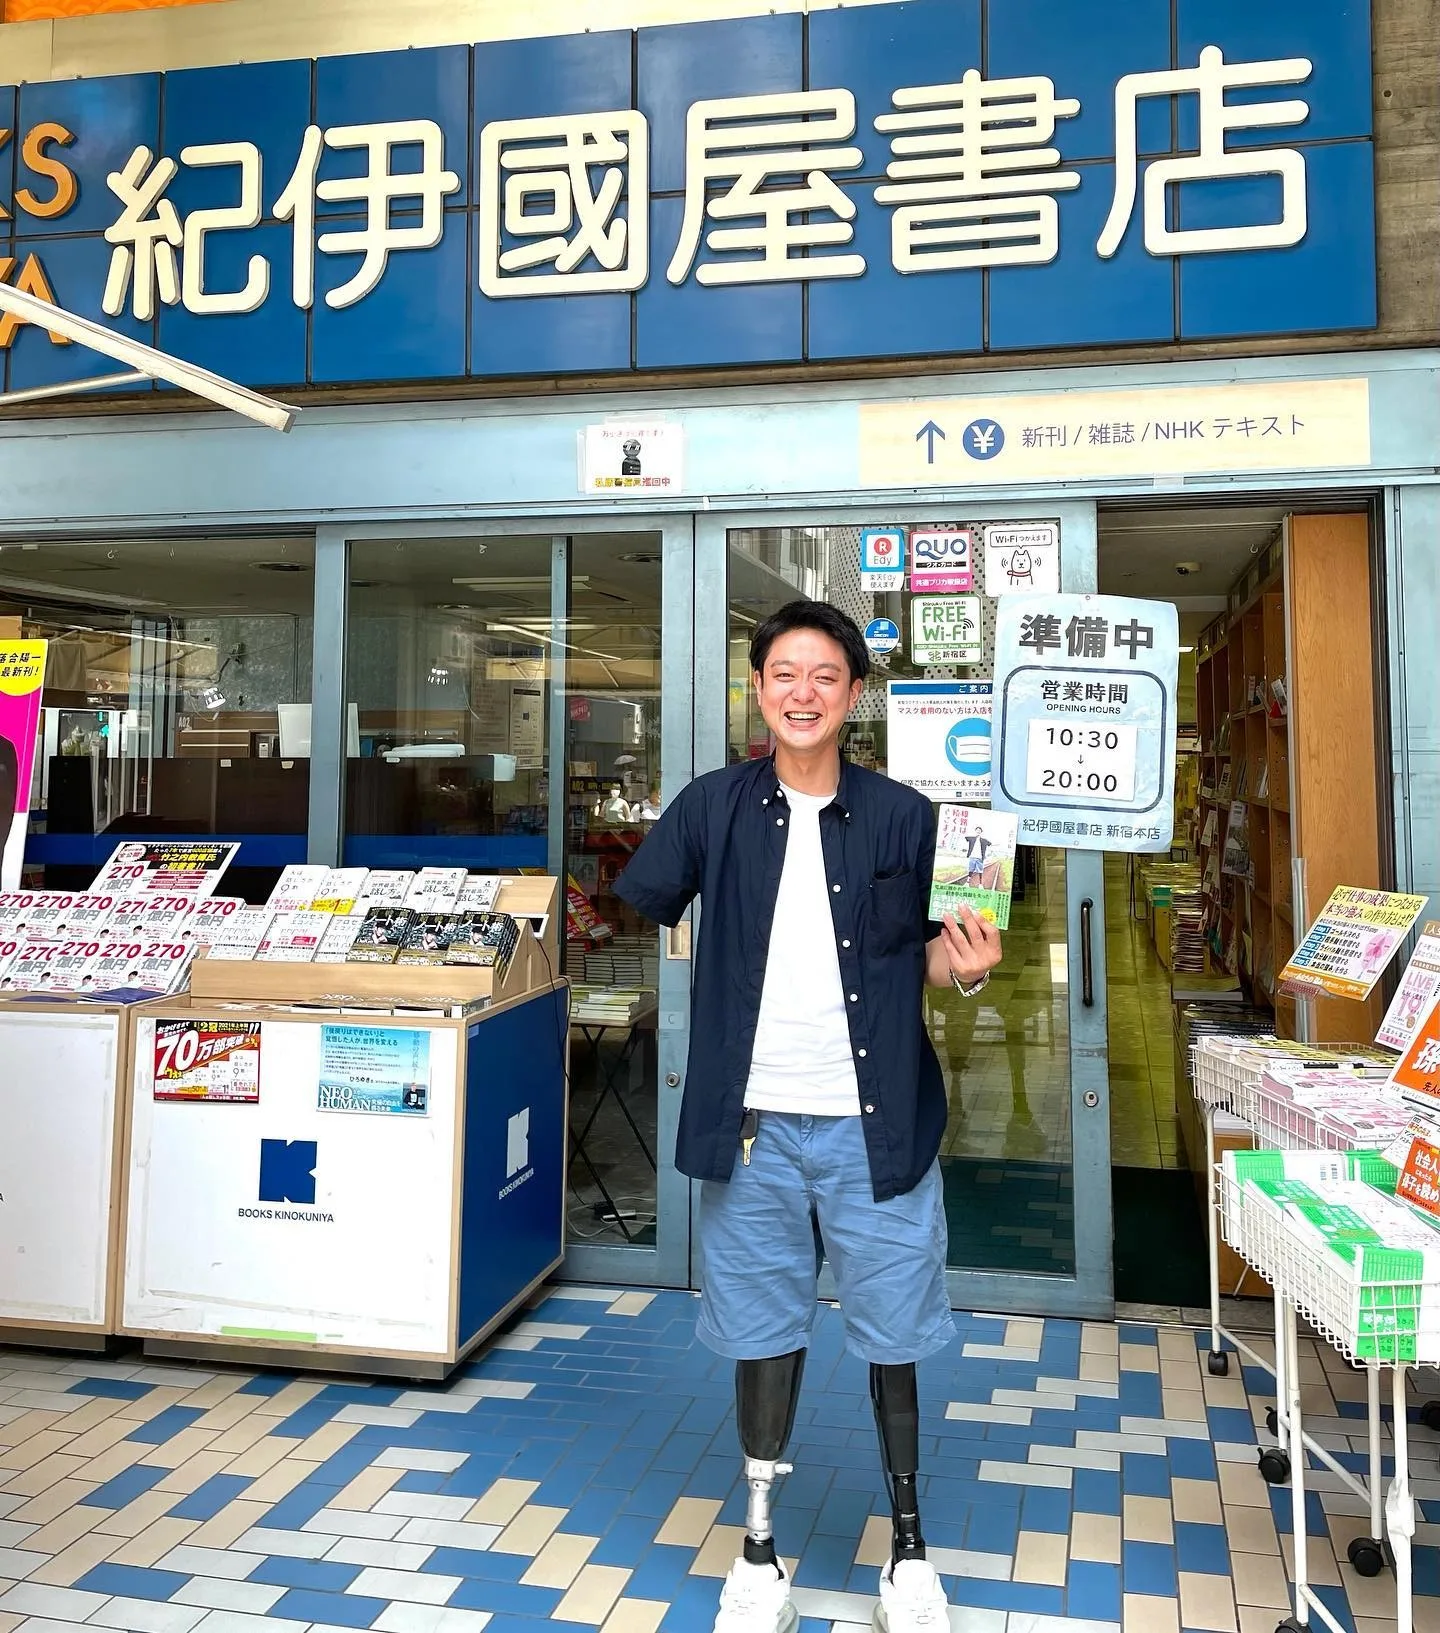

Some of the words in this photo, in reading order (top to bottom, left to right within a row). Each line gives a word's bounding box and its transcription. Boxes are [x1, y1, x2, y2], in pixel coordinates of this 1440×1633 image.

[102, 45, 1313, 321] 紀伊國屋書店
[0, 252, 73, 348] A
[1022, 426, 1067, 448] 新刊
[1088, 422, 1136, 445] 雑誌
[1212, 414, 1305, 438] テキスト
[915, 538, 967, 560] QUO
[873, 555, 893, 566] Edy
[922, 606, 966, 623] FREE
[922, 625, 967, 641] Wi-Fi
[1019, 614, 1154, 660] 準備中
[1040, 679, 1129, 704] 営業時間
[1046, 703, 1087, 714] OPENING
[1089, 705, 1121, 715] HOURS
[1046, 727, 1119, 750] 10:30
[1042, 769, 1118, 792] 20:00
[1022, 818, 1102, 837] 紀伊國屋書店
[1106, 823, 1161, 840] 新宿本店
[107, 865, 145, 879] 270
[106, 878, 134, 890] 億円
[0, 895, 33, 908] 270
[33, 895, 73, 909] 270
[72, 895, 113, 910] 270
[148, 898, 188, 911] 270
[197, 902, 236, 915] 270
[31, 909, 60, 920] 億円
[71, 909, 101, 920] 億円
[146, 910, 176, 922] 億円
[195, 915, 225, 927] 億円
[58, 942, 100, 957] 270
[100, 943, 141, 959] 270
[143, 943, 185, 959] 270
[16, 961, 47, 973] 億円
[56, 956, 87, 968] 億円
[97, 958, 129, 970] 億円
[141, 958, 172, 971] 億円
[319, 1085, 353, 1100] NEO
[319, 1097, 372, 1112] HUMAN
[238, 1208, 273, 1220] BOOKS
[275, 1210, 335, 1223] KINOKUNIYA
